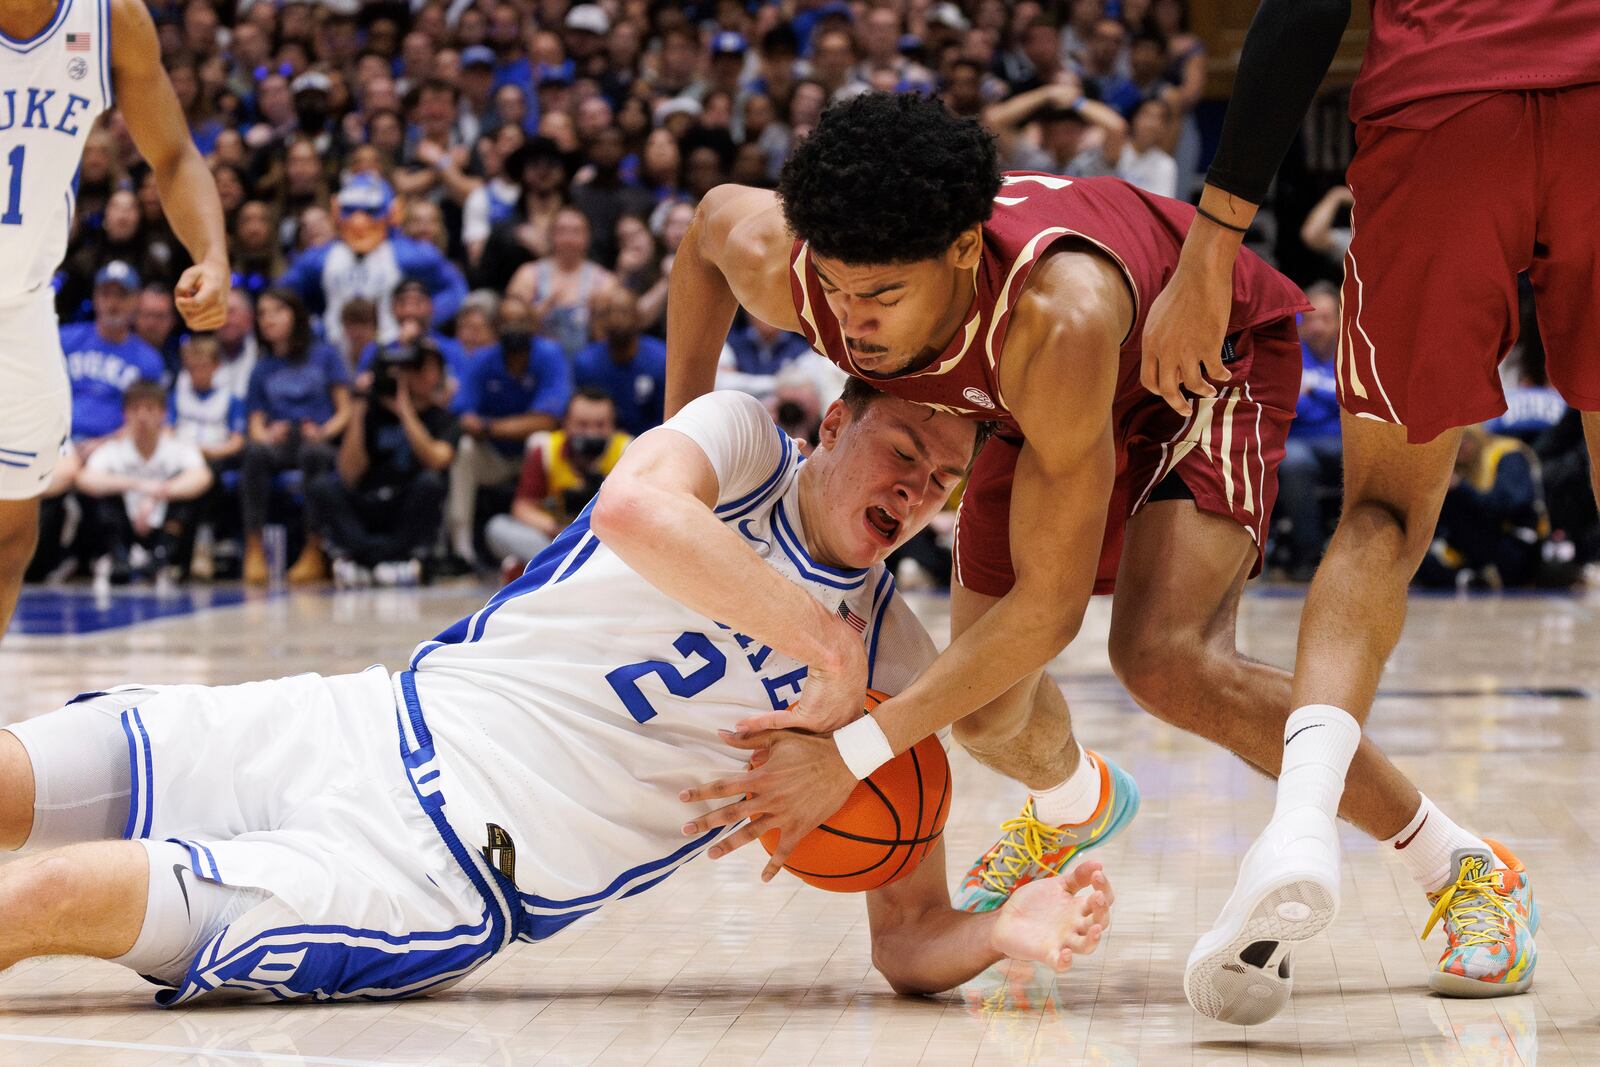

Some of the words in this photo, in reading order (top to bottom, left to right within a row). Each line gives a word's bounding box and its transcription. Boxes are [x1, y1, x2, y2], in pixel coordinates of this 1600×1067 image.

[0, 87, 91, 136] UKE
[1, 144, 26, 225] 1
[604, 630, 727, 724] 2
